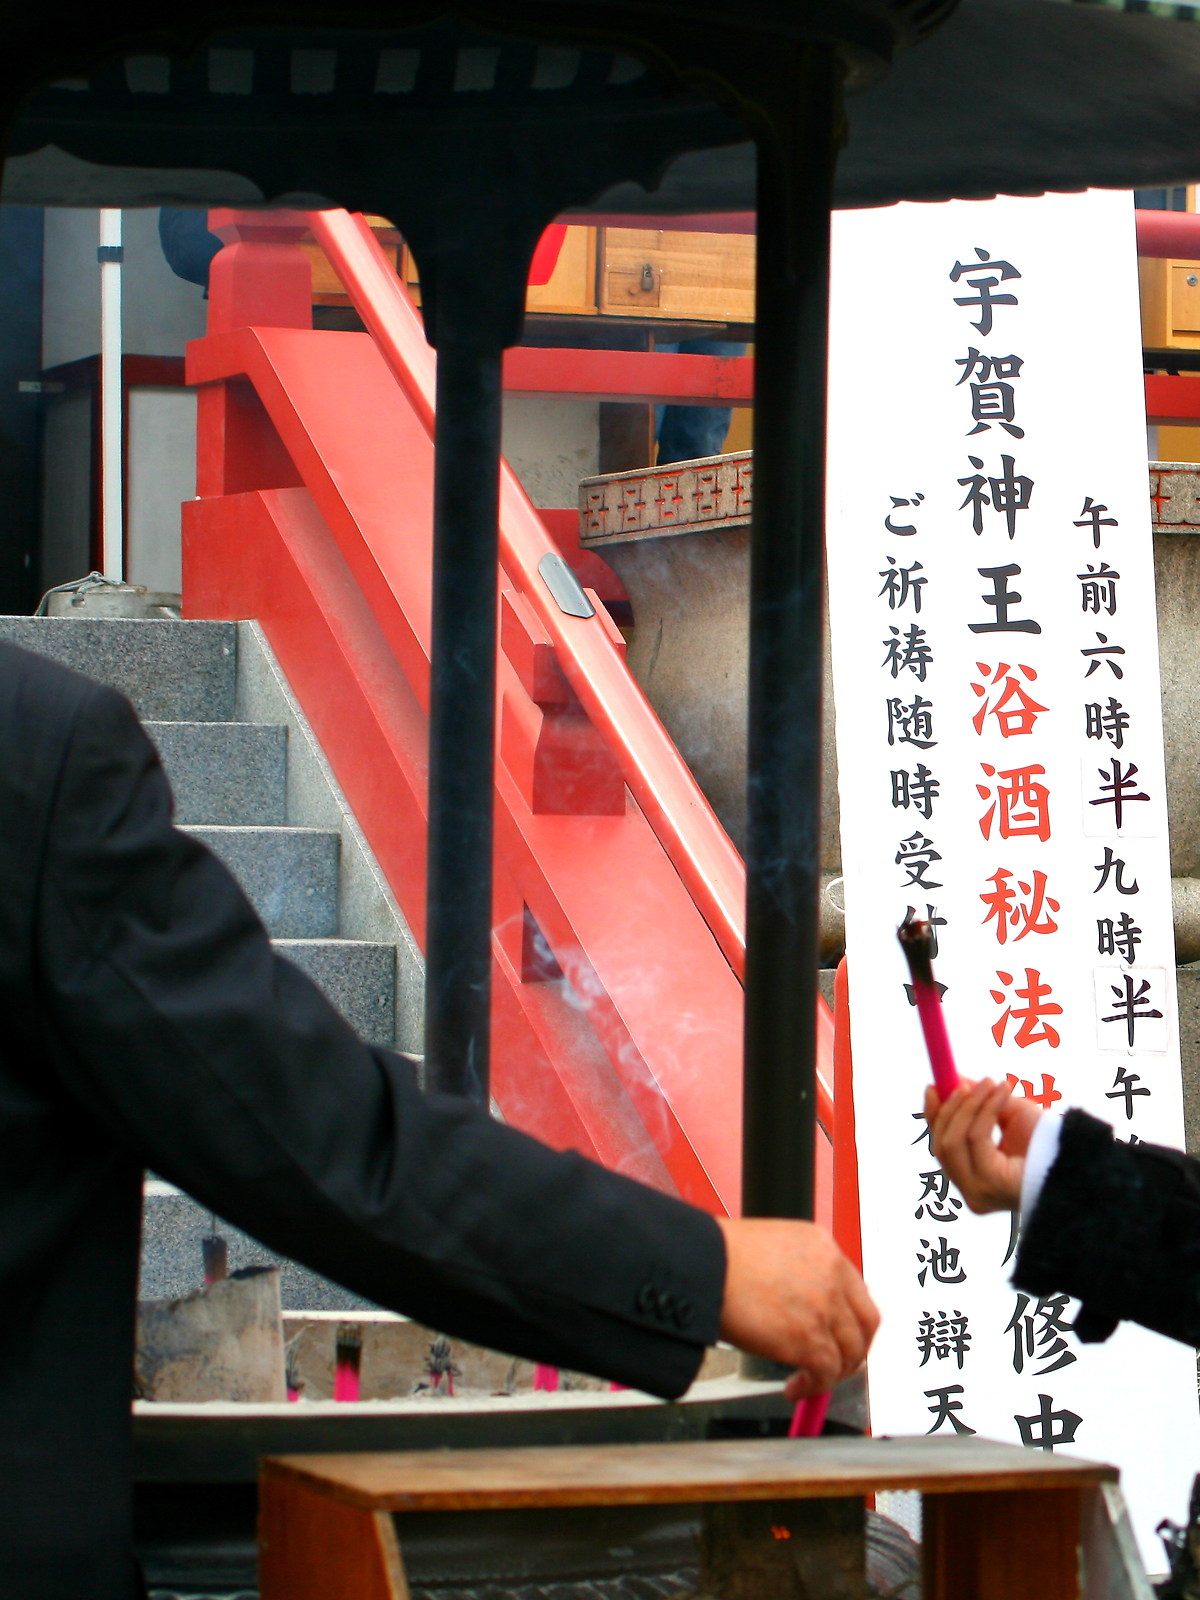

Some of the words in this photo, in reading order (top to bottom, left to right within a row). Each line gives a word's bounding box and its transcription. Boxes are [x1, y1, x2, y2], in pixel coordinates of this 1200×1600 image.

[1072, 496, 1163, 1144] 午前六時半九時半午
